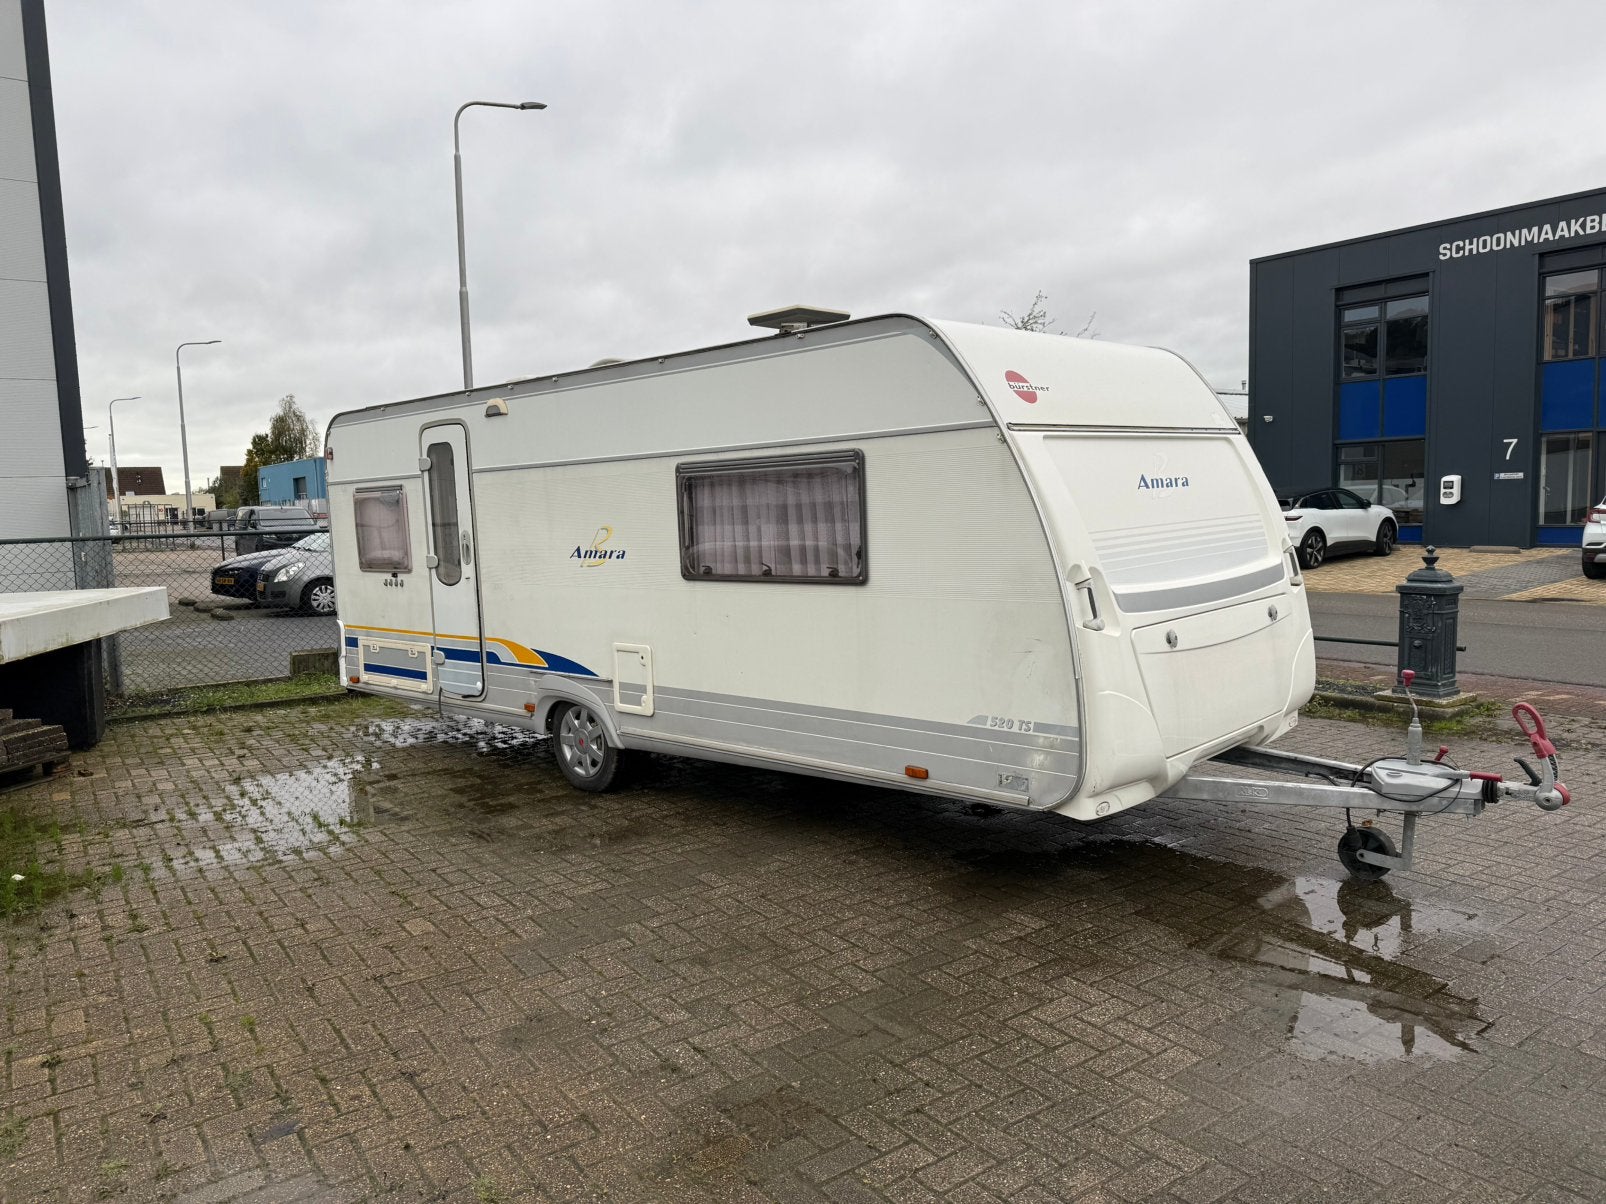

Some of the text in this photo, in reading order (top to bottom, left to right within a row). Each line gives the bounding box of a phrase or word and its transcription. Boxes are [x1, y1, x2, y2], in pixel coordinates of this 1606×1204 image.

[1007, 382, 1050, 391] bürstner
[1503, 438, 1518, 460] 7
[1137, 473, 1189, 490] Amara
[570, 545, 626, 560] Amara
[990, 715, 1032, 732] 520 TS
